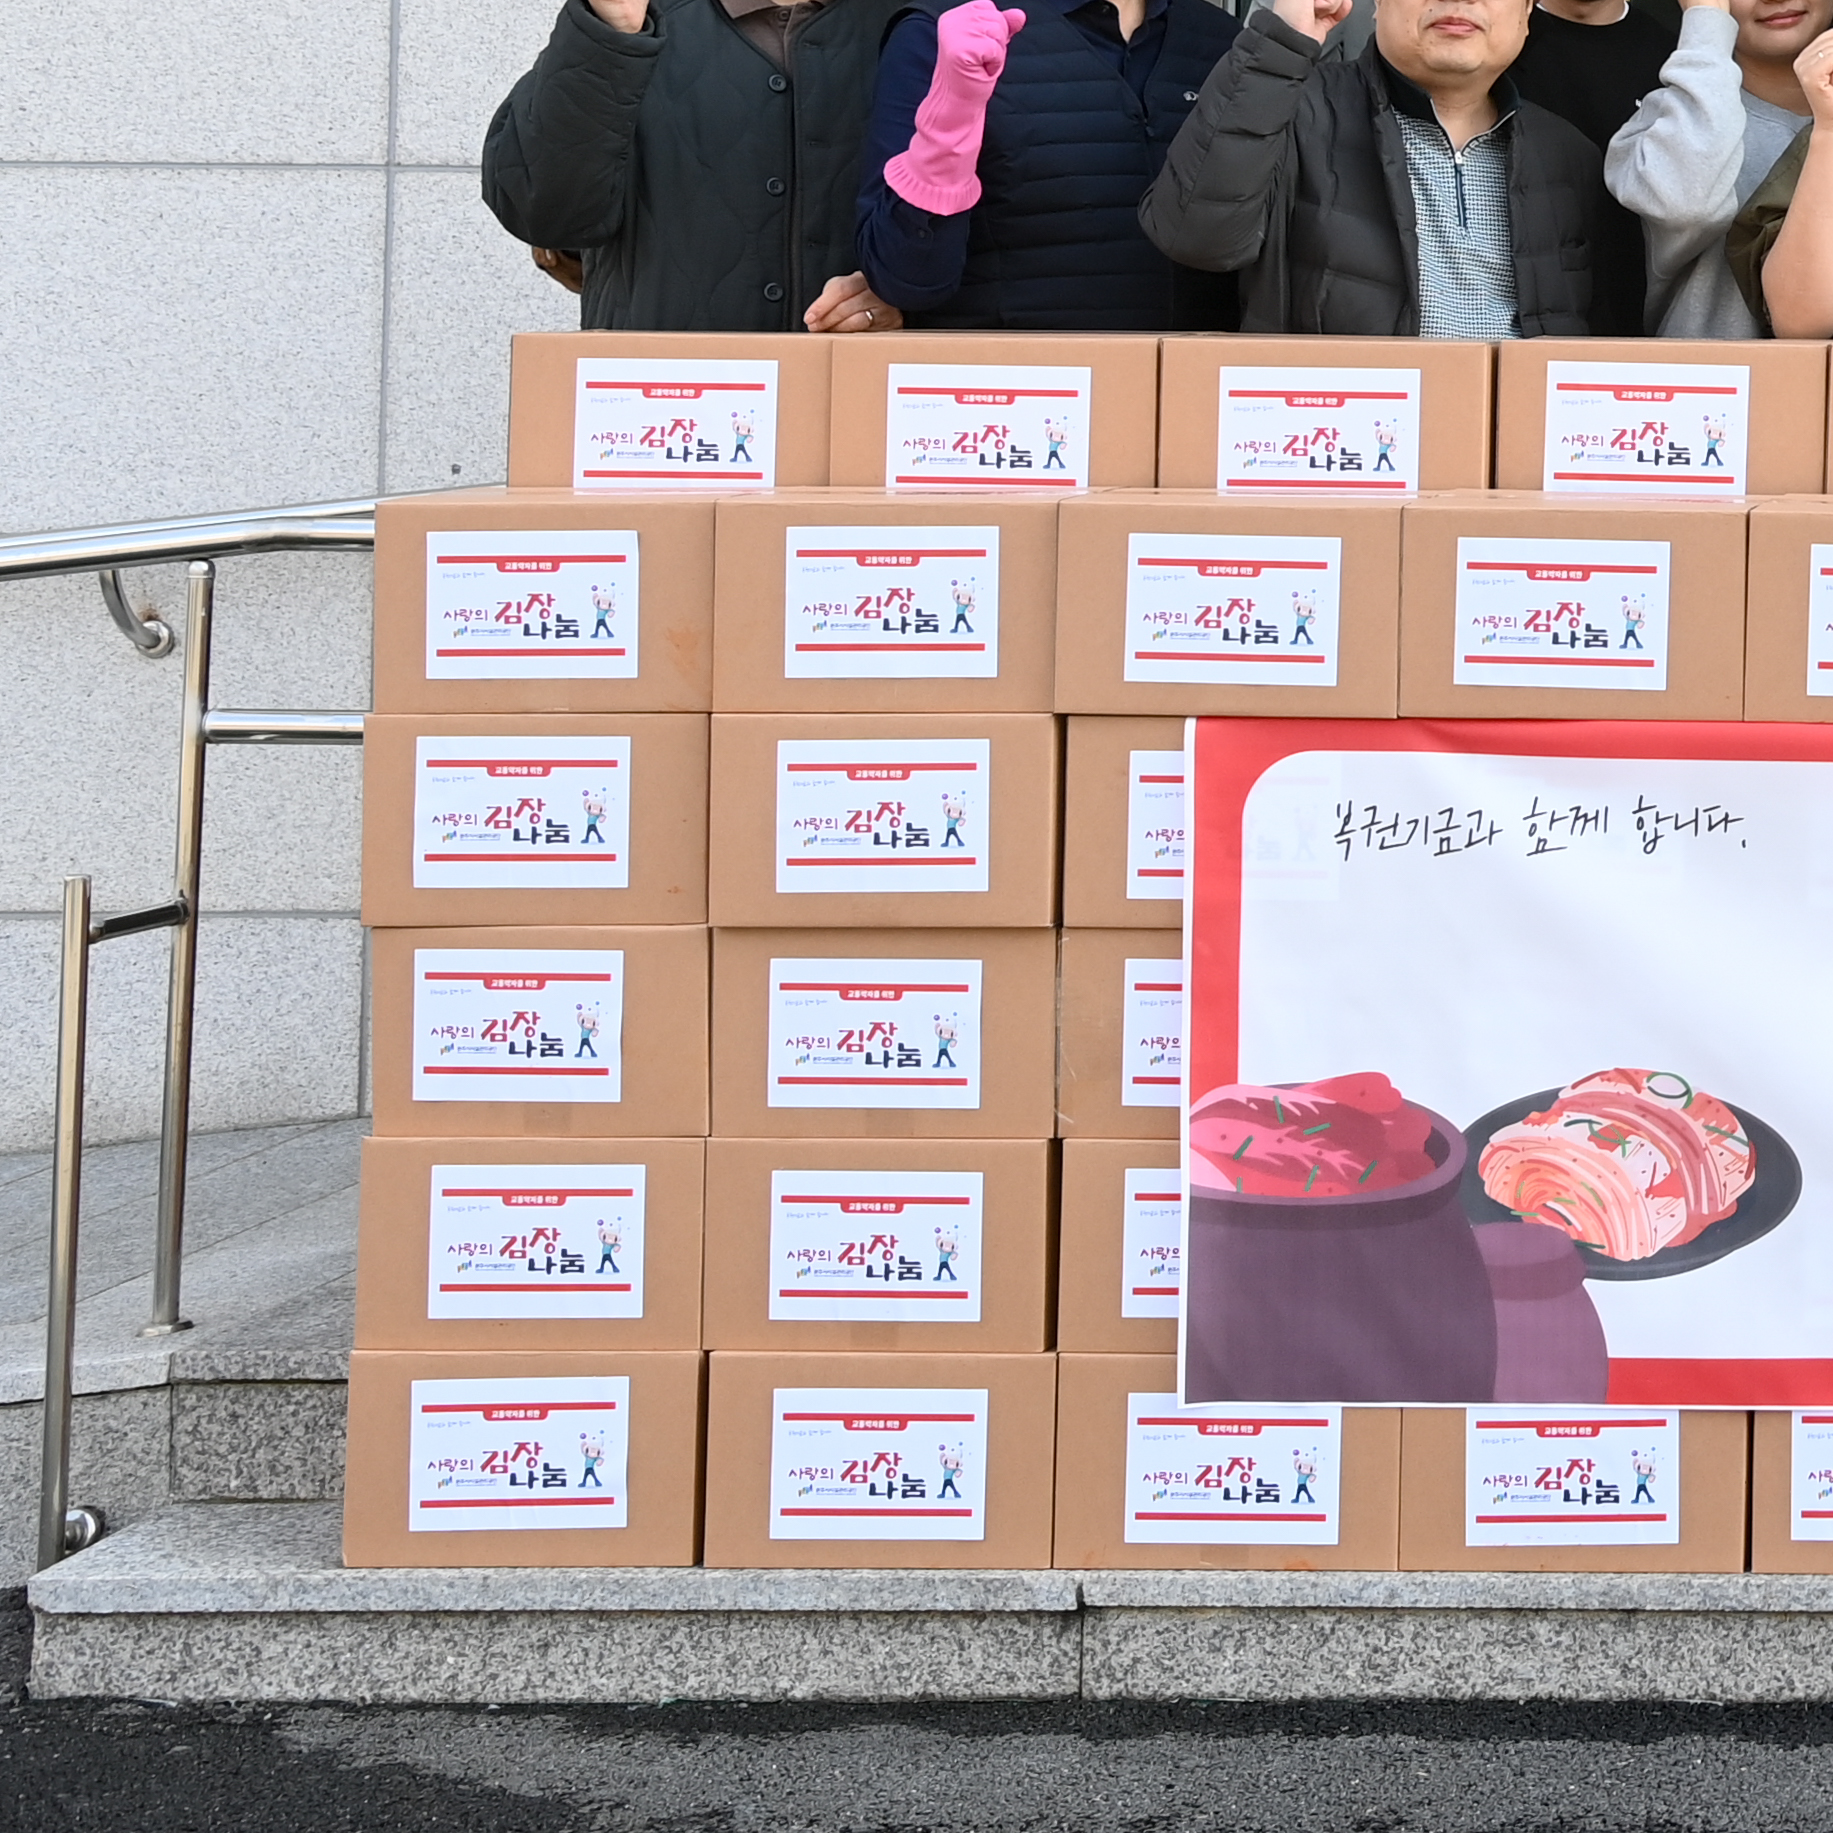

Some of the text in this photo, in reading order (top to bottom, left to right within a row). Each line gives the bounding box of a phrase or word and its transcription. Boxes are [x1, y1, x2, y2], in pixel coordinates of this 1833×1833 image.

[591, 418, 697, 448] 사랑의 김장
[1234, 427, 1340, 457] 사랑의 김장
[665, 438, 720, 463] 나눔
[1309, 447, 1363, 472] 나눔
[803, 587, 915, 619] 사랑의 김장
[1472, 601, 1585, 633] 사랑의 김장
[882, 608, 939, 634] 나눔
[1551, 622, 1609, 649] 나눔
[793, 801, 906, 833] 사랑의 김장
[1334, 794, 1746, 862] 복권기금과 함께 합니다.
[873, 822, 930, 849] 나눔
[431, 1011, 541, 1043] 사랑의 김장
[508, 1032, 564, 1058] 나눔
[787, 1234, 899, 1266] 사랑의 김장
[865, 1255, 922, 1282] 나눔
[428, 1442, 543, 1474] 사랑의 김장
[1143, 1456, 1256, 1489] 사랑의 김장
[509, 1462, 567, 1489] 나눔
[1223, 1477, 1280, 1504] 나눔
